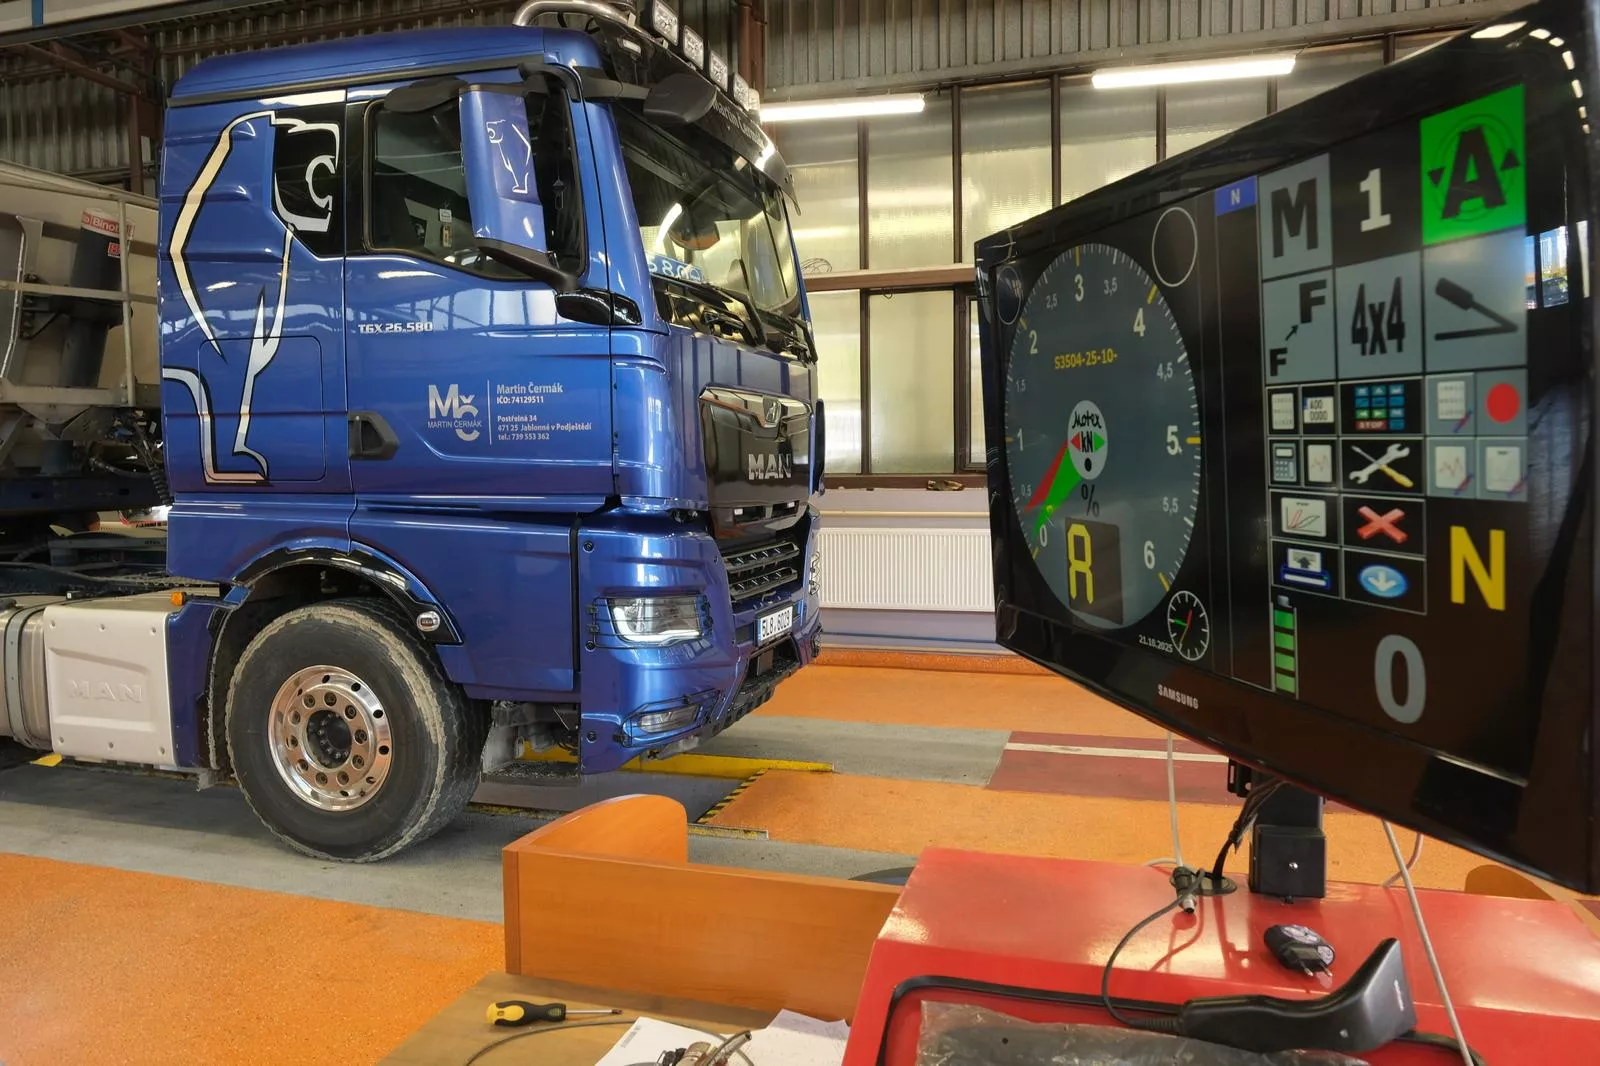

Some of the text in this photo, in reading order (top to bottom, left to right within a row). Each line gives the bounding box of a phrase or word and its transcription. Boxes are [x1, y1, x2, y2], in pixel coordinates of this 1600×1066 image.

[1442, 126, 1507, 220] A
[1231, 190, 1240, 205] N
[1360, 168, 1391, 232] 1
[1271, 177, 1321, 258] M
[1074, 274, 1084, 302] 3
[1104, 277, 1118, 296] 3,5
[1046, 293, 1058, 309] 2,5
[1300, 279, 1327, 324] F
[358, 321, 433, 334] TGX 26.580
[1133, 307, 1146, 337] 4
[1029, 330, 1038, 354] 2
[1156, 362, 1173, 382] 4,5
[1269, 347, 1287, 376] F
[496, 381, 564, 394] Martin Čermák
[496, 395, 544, 404] IČO: 74129511
[427, 418, 482, 429] MARTIN ČERMÁK
[497, 414, 528, 422] Postřelná
[498, 424, 509, 432] 471
[510, 424, 519, 432] 25
[520, 423, 550, 431] Jablonné
[556, 422, 592, 432] Podještědí
[1359, 420, 1384, 429] STOP
[525, 432, 537, 440] 553
[538, 432, 550, 440] 362
[1017, 428, 1023, 451] 1
[1081, 430, 1093, 453] kN
[749, 454, 791, 480] MAN
[1162, 496, 1178, 514] 5,5
[1039, 524, 1048, 548] 0
[1144, 541, 1155, 569] 6
[1451, 525, 1505, 611] N
[1139, 634, 1173, 653] 21.10.2025
[1375, 634, 1426, 724] 0
[69, 679, 142, 703] MAN
[1158, 683, 1199, 709] SAMSUNG
